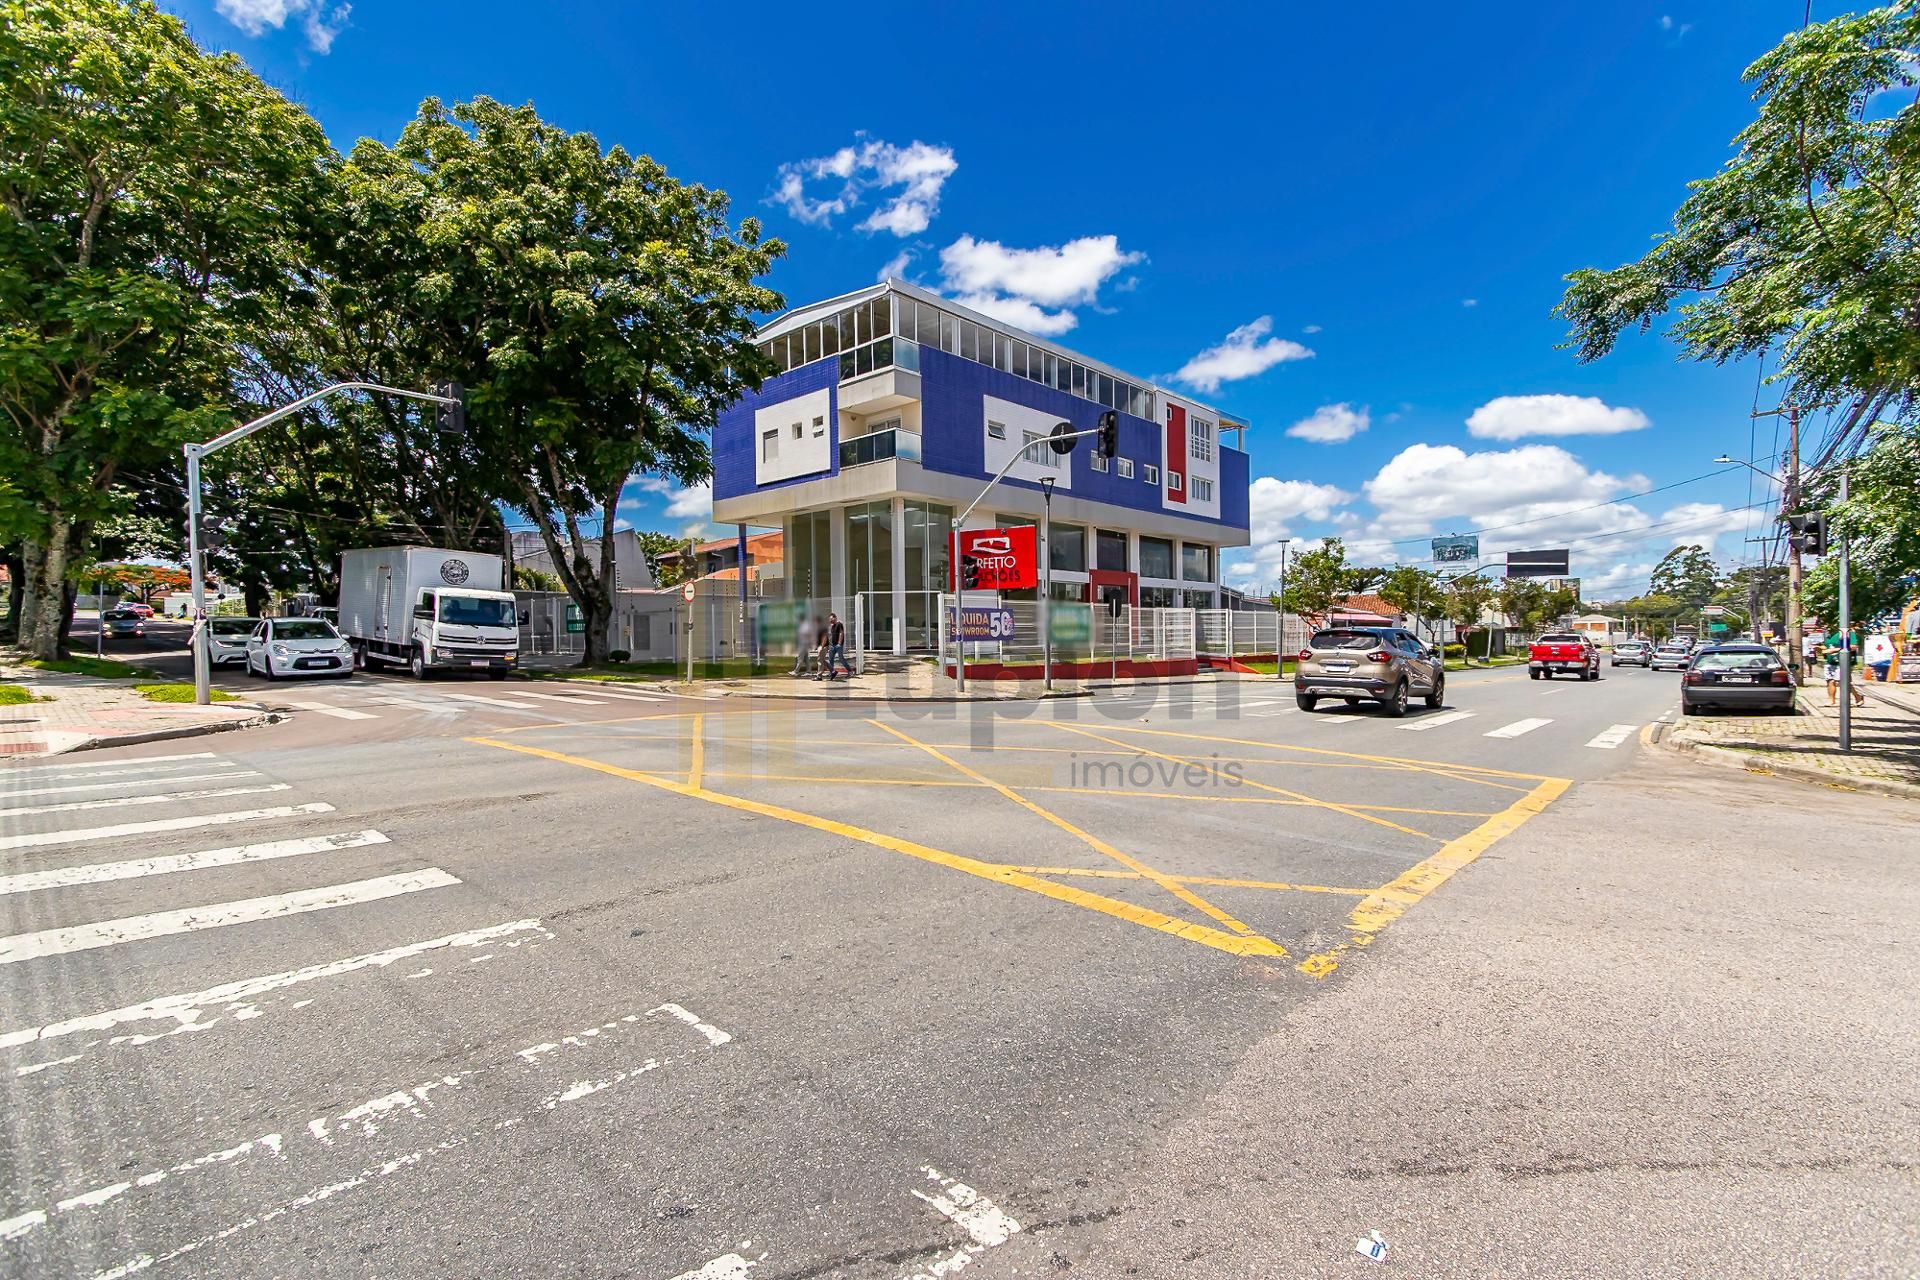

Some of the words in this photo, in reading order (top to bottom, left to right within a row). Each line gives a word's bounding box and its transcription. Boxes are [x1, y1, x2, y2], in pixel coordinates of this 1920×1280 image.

[976, 555, 1016, 569] RFETTO
[950, 612, 989, 626] LQUIDA
[951, 626, 989, 636] SOWROOM
